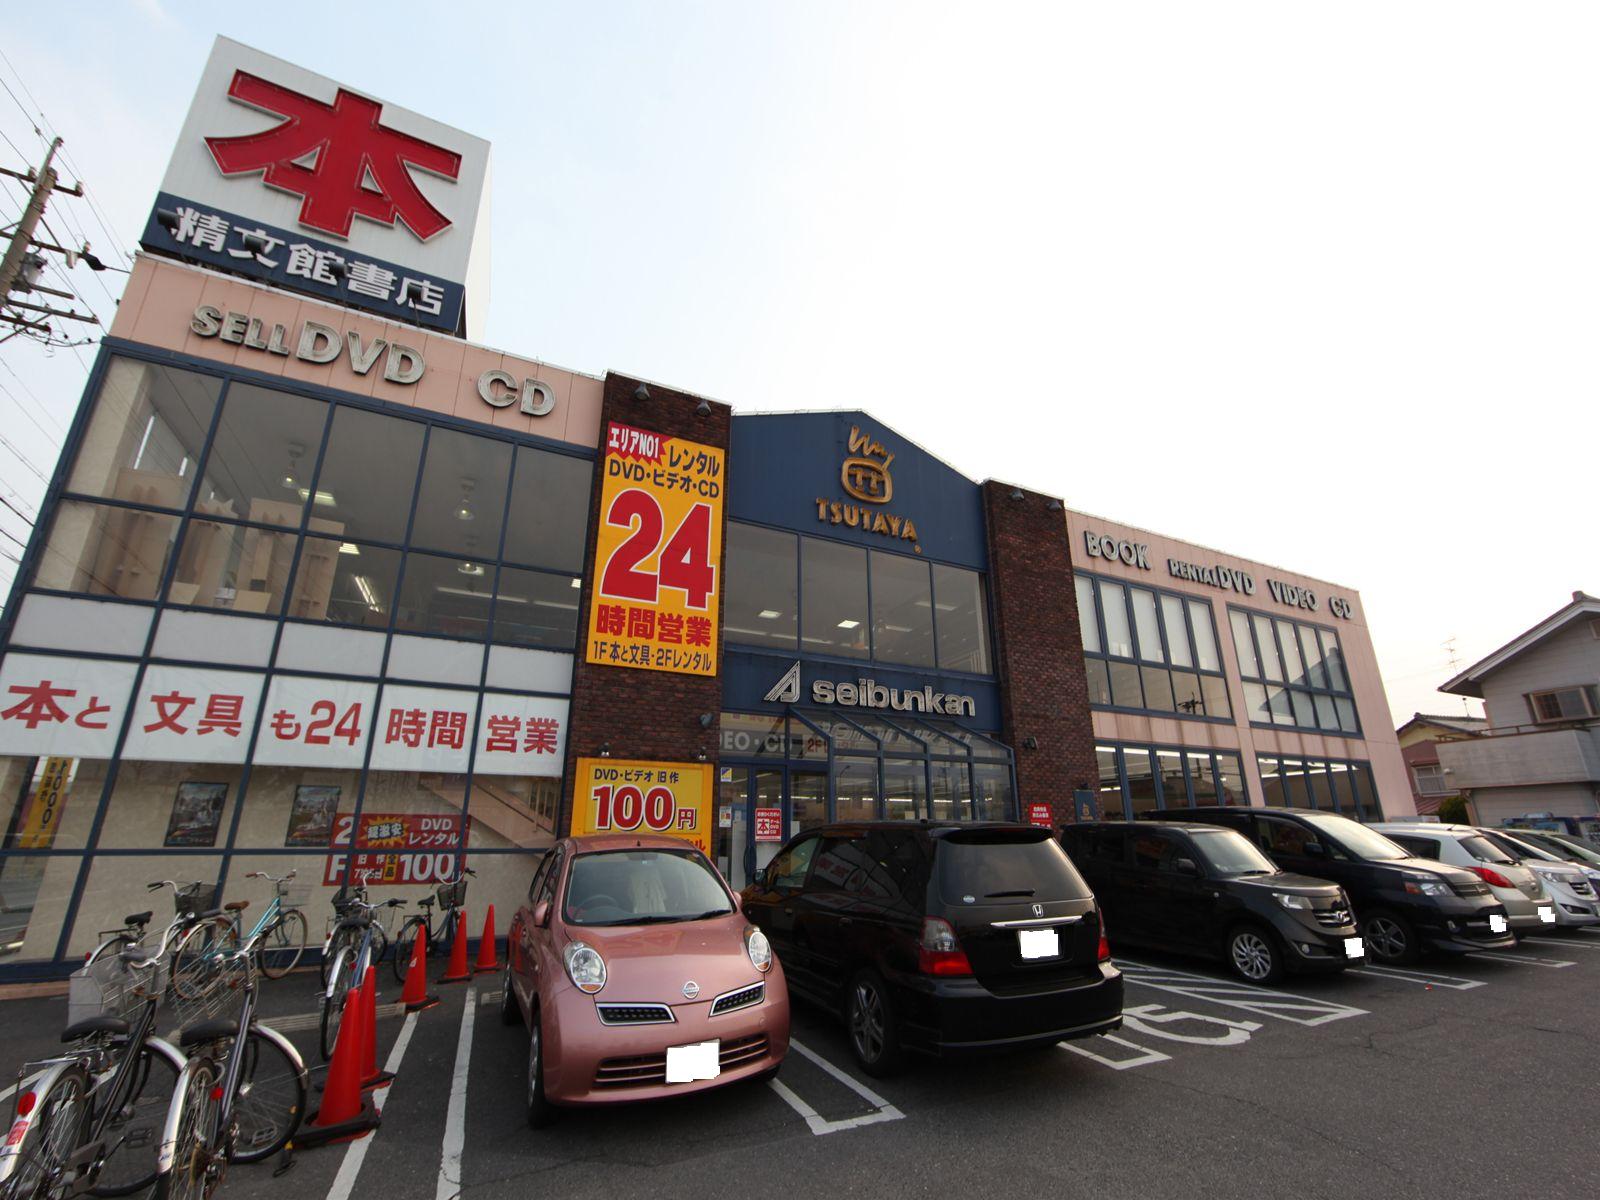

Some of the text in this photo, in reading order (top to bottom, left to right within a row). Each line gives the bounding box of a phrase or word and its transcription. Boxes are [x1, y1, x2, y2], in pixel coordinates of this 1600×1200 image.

[203, 70, 462, 242] 本
[174, 206, 445, 318] 精文館書店
[478, 369, 555, 417] CD
[669, 445, 720, 477] レンタル
[816, 498, 918, 541] TSUTAYA
[600, 488, 715, 611] 24
[1084, 530, 1151, 570] BOOK
[1267, 579, 1319, 612] VIDEO
[1329, 596, 1354, 620] CD
[596, 604, 712, 648] 時間営業
[812, 678, 976, 717] seibunkan
[409, 832, 460, 846] レンタル
[420, 818, 452, 831] DVD
